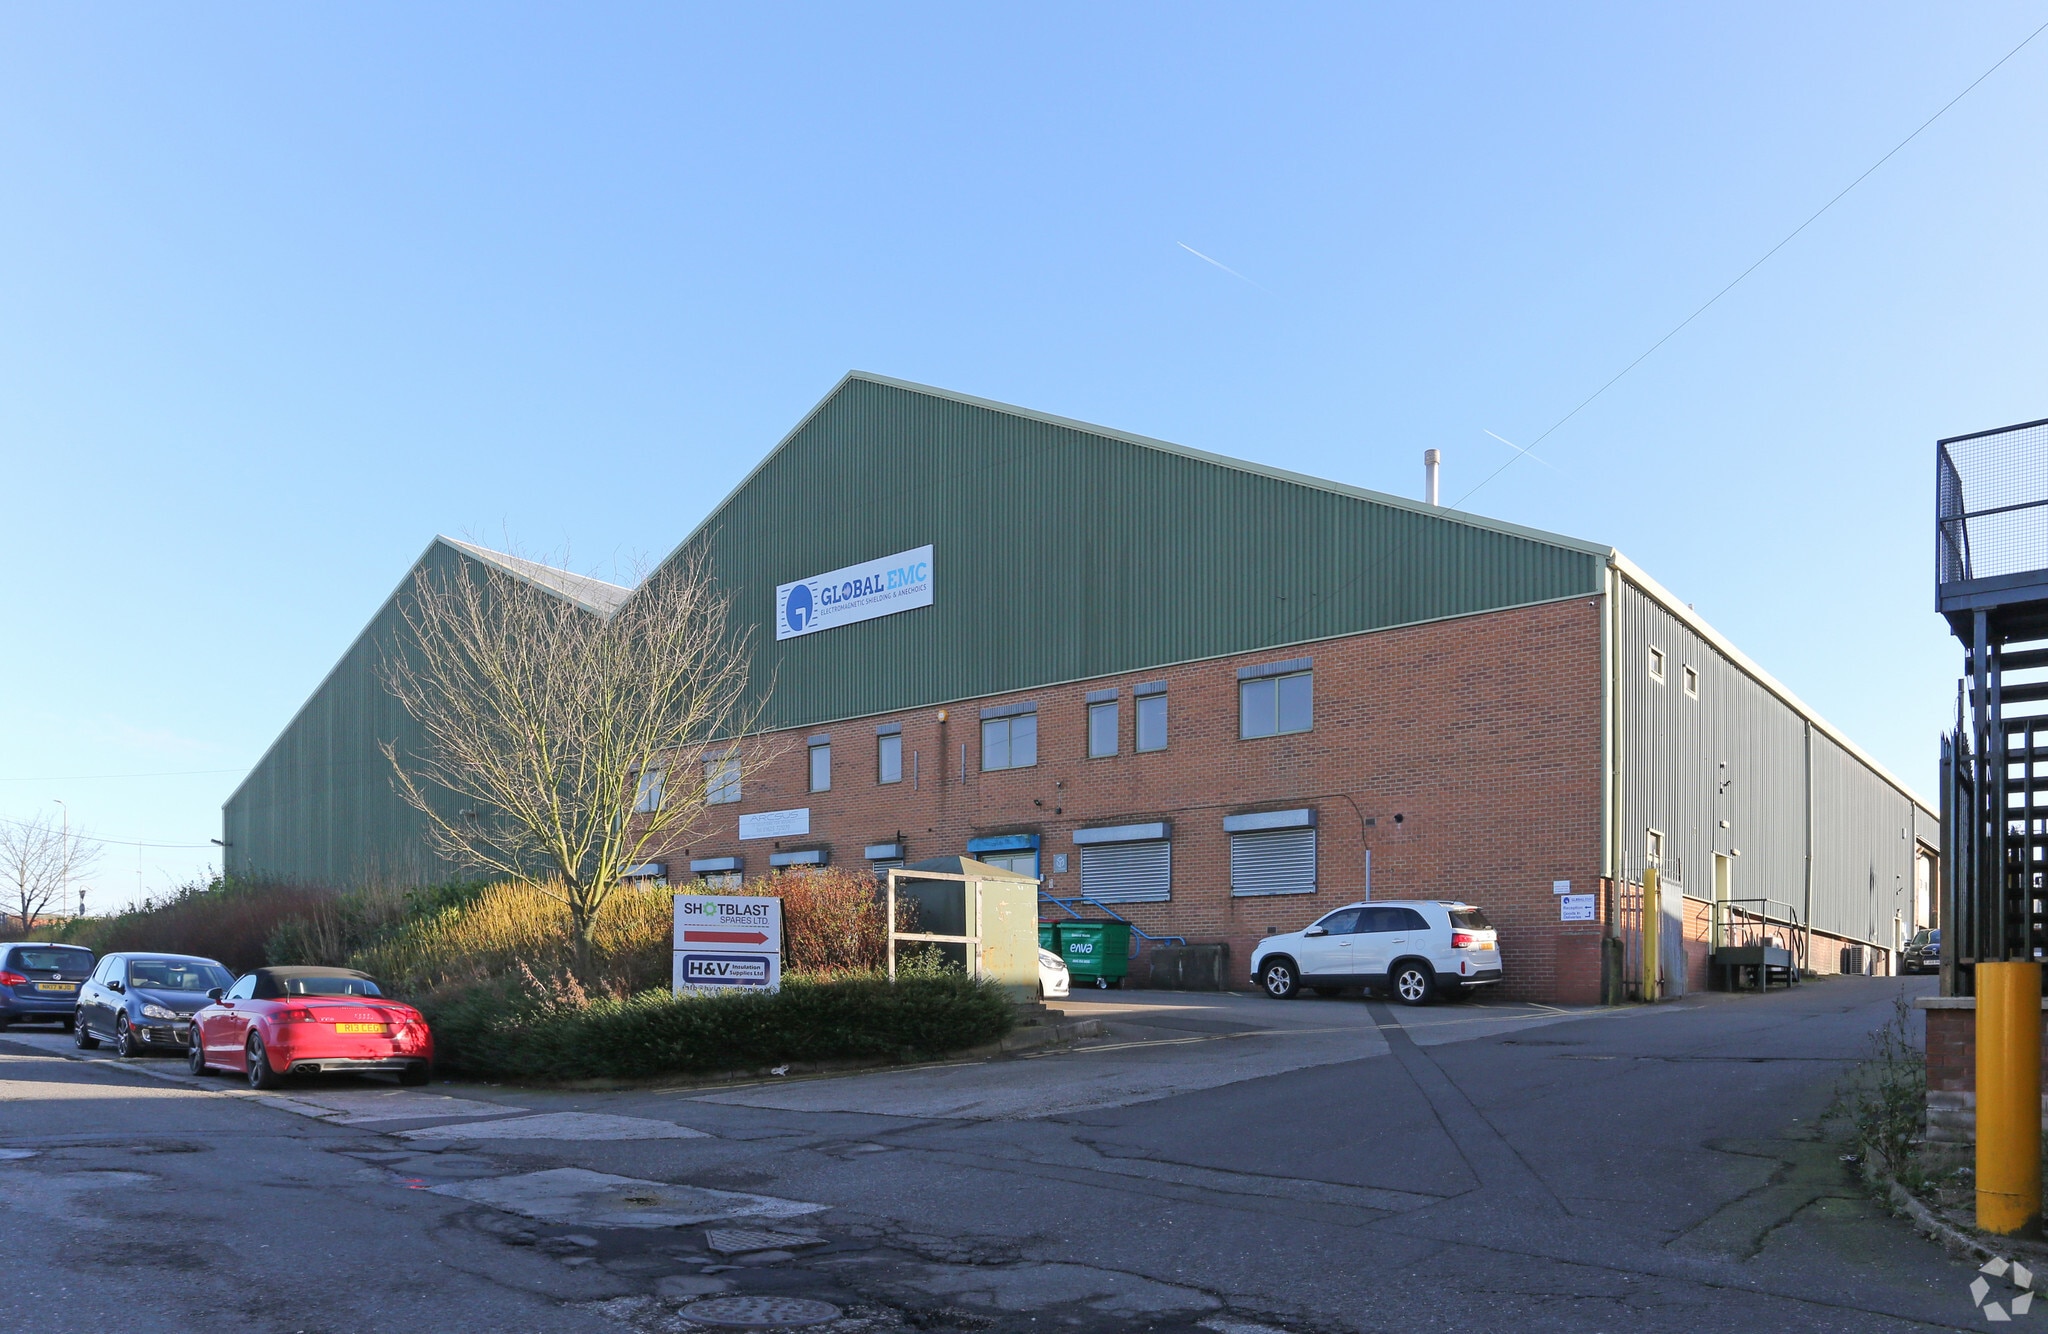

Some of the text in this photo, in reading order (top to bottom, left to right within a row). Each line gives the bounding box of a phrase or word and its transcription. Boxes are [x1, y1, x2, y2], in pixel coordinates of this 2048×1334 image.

[821, 562, 927, 606] GLOBAL EMC
[820, 599, 865, 616] ELECTROMAGNETIC
[865, 593, 892, 606] SHIELDING
[897, 583, 927, 598] ANECHOICS
[750, 811, 799, 822] ARCSUS
[684, 901, 770, 916] SHOTBLAST
[720, 916, 770, 925] SPARES LTD.
[1069, 943, 1093, 954] enva
[690, 962, 730, 976] H&V
